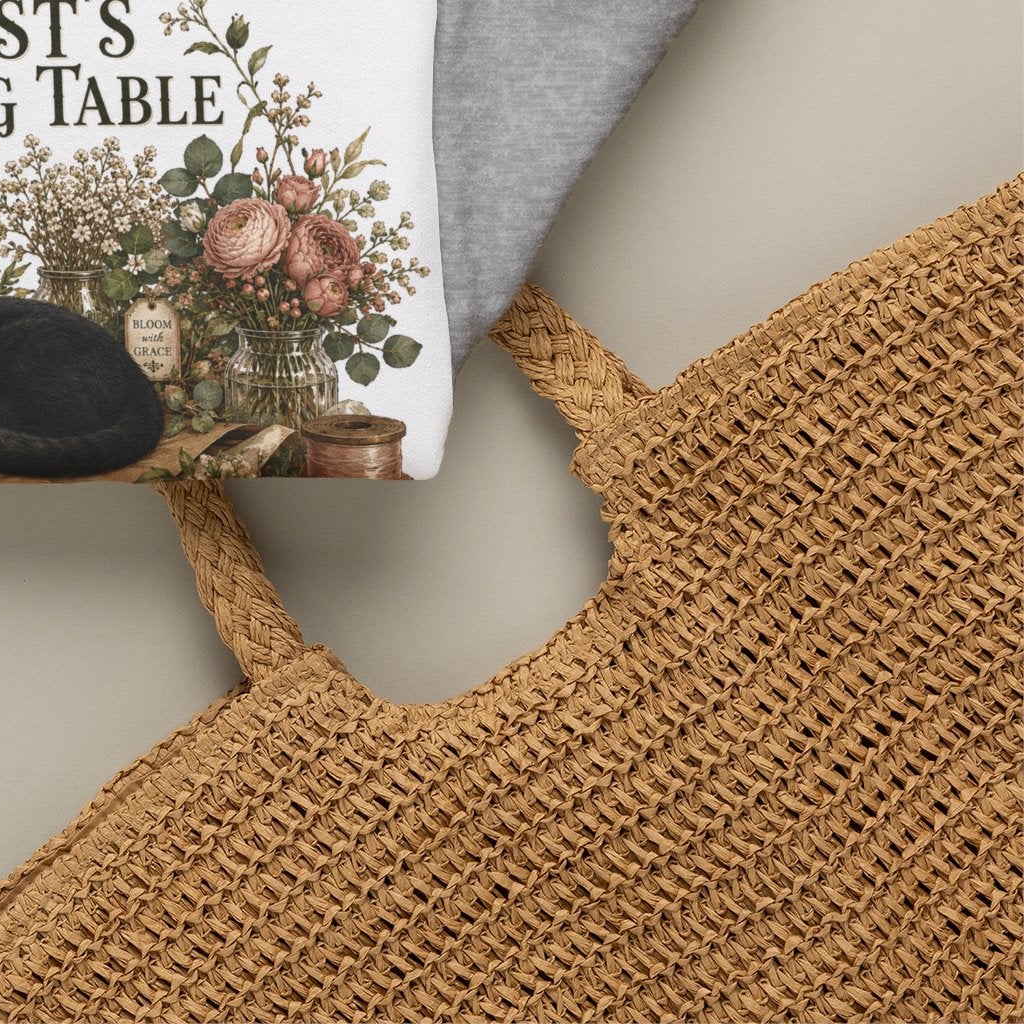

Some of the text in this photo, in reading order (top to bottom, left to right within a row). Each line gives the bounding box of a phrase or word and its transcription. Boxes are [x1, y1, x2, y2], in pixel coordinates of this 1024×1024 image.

[35, 63, 225, 128] TABLE
[132, 319, 172, 330] BLOOM
[142, 331, 164, 343] with
[133, 346, 172, 357] GRACE
